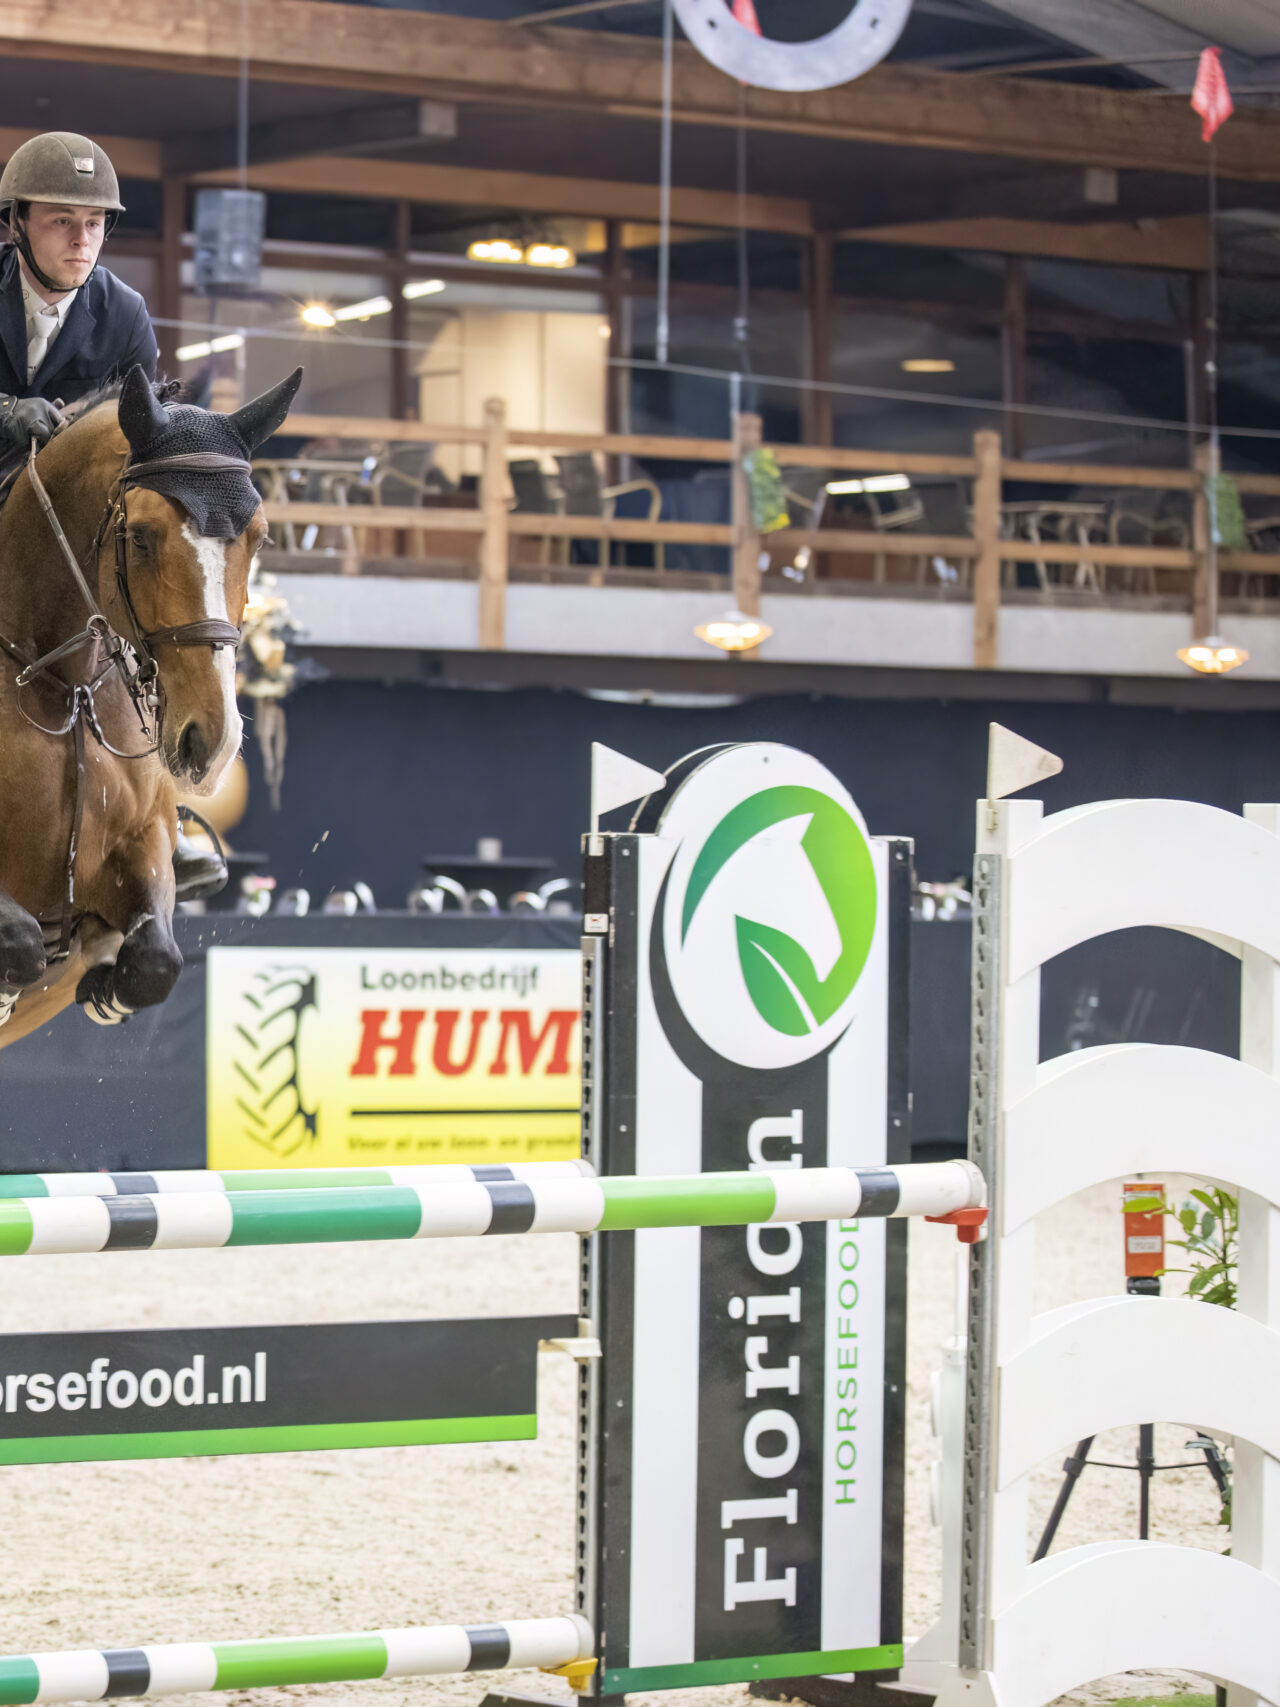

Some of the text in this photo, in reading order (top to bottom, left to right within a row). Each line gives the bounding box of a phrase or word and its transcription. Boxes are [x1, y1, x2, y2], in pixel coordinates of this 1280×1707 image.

[360, 965, 539, 998] Loonbedrijf
[350, 1010, 582, 1076] HUM
[721, 1109, 804, 1612] Florian
